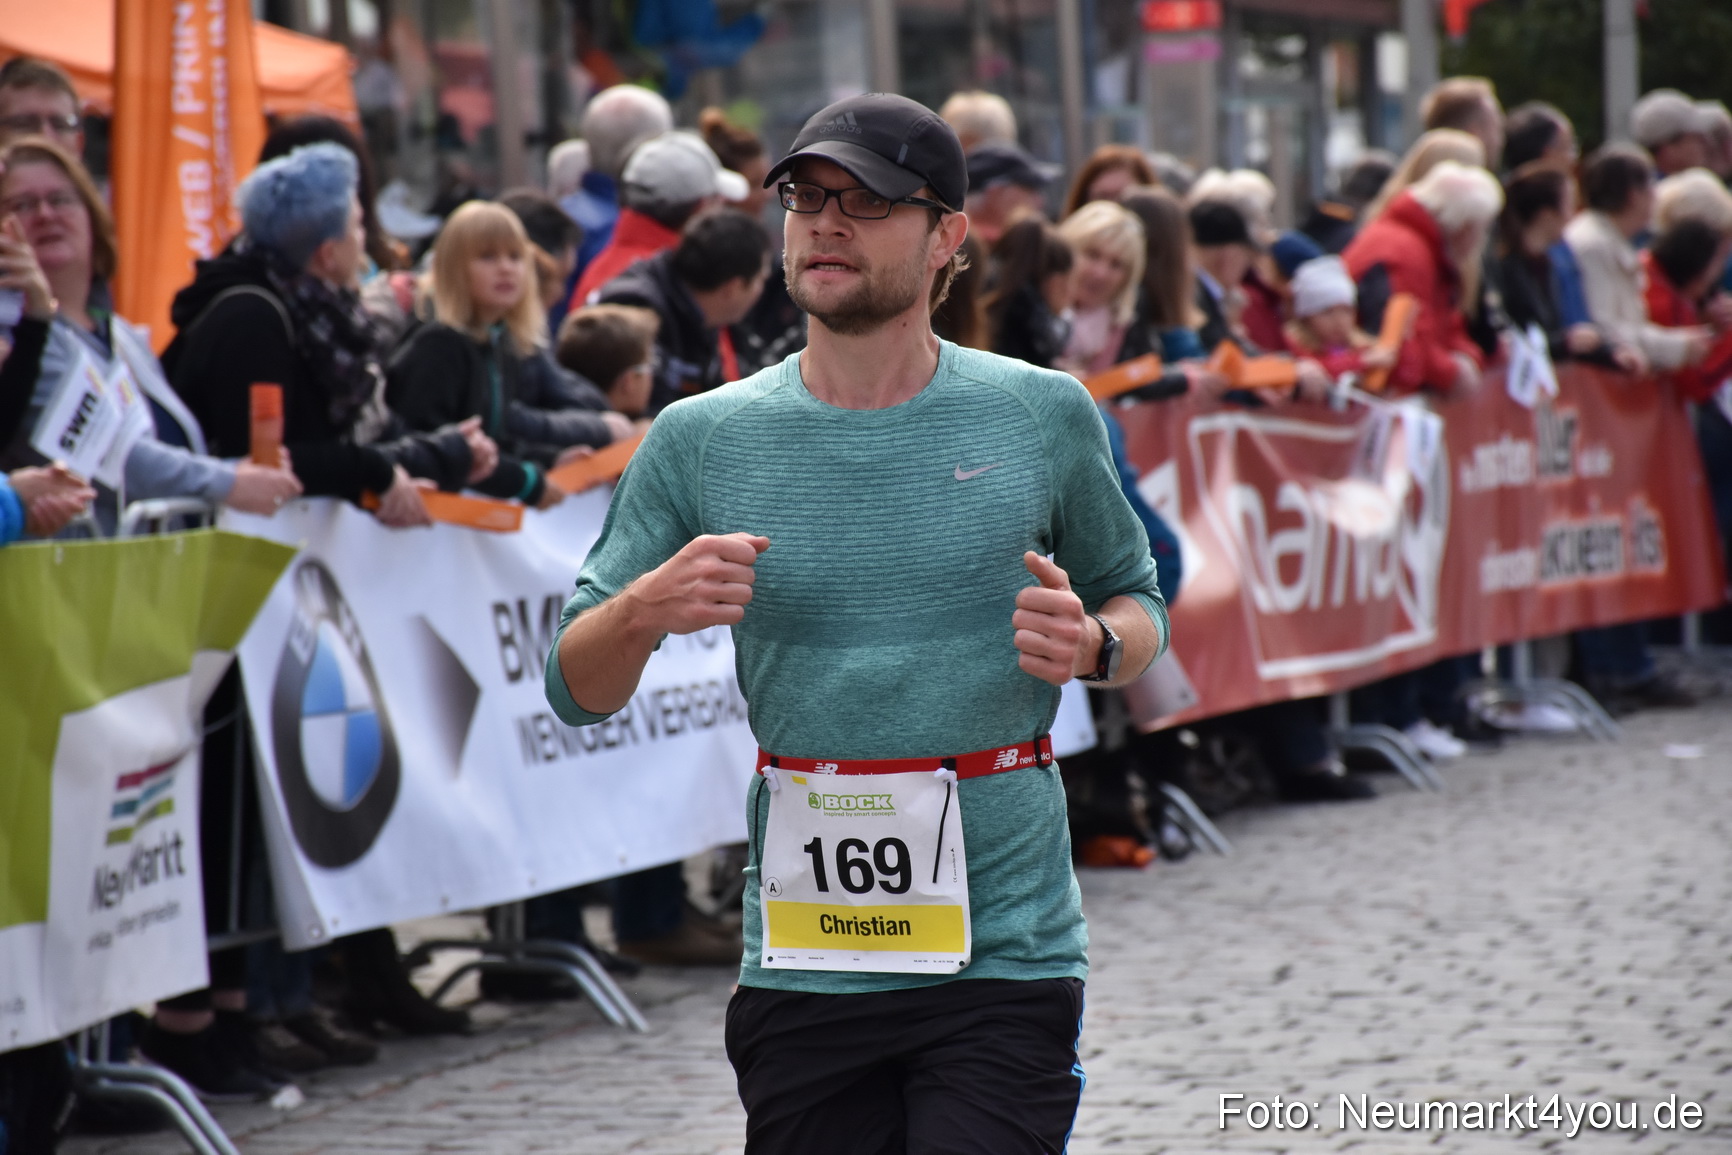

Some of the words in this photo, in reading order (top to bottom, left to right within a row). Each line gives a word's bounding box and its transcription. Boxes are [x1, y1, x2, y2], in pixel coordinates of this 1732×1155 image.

[819, 120, 862, 135] adidas
[59, 391, 98, 455] swn
[492, 592, 568, 684] BM
[822, 794, 895, 811] BOCK
[803, 836, 912, 895] 169
[769, 882, 777, 893] A
[820, 914, 912, 937] Christian
